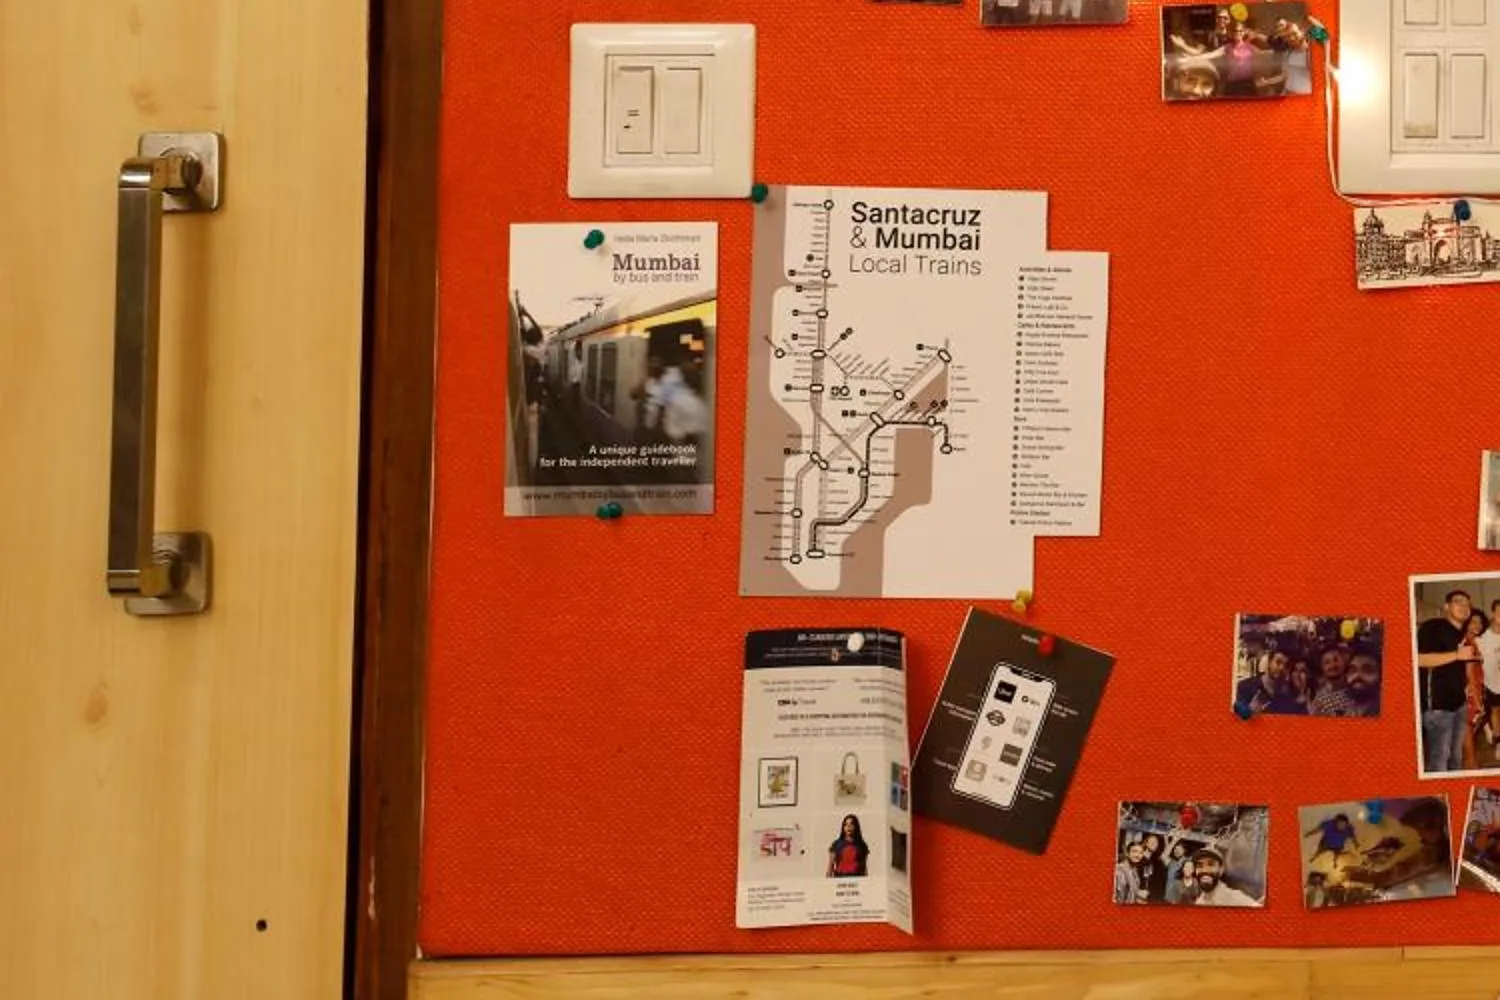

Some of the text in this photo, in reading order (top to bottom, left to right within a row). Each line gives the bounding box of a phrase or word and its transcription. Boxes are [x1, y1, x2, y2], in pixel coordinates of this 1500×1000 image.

[851, 201, 981, 226] Santacruz
[850, 225, 980, 250] & Mumbai
[612, 253, 700, 271] Mumbai
[849, 254, 982, 275] Local Trains
[613, 272, 699, 284] by bus and train
[588, 445, 697, 456] A unique guidebook
[539, 456, 697, 468] for the independent traveller
